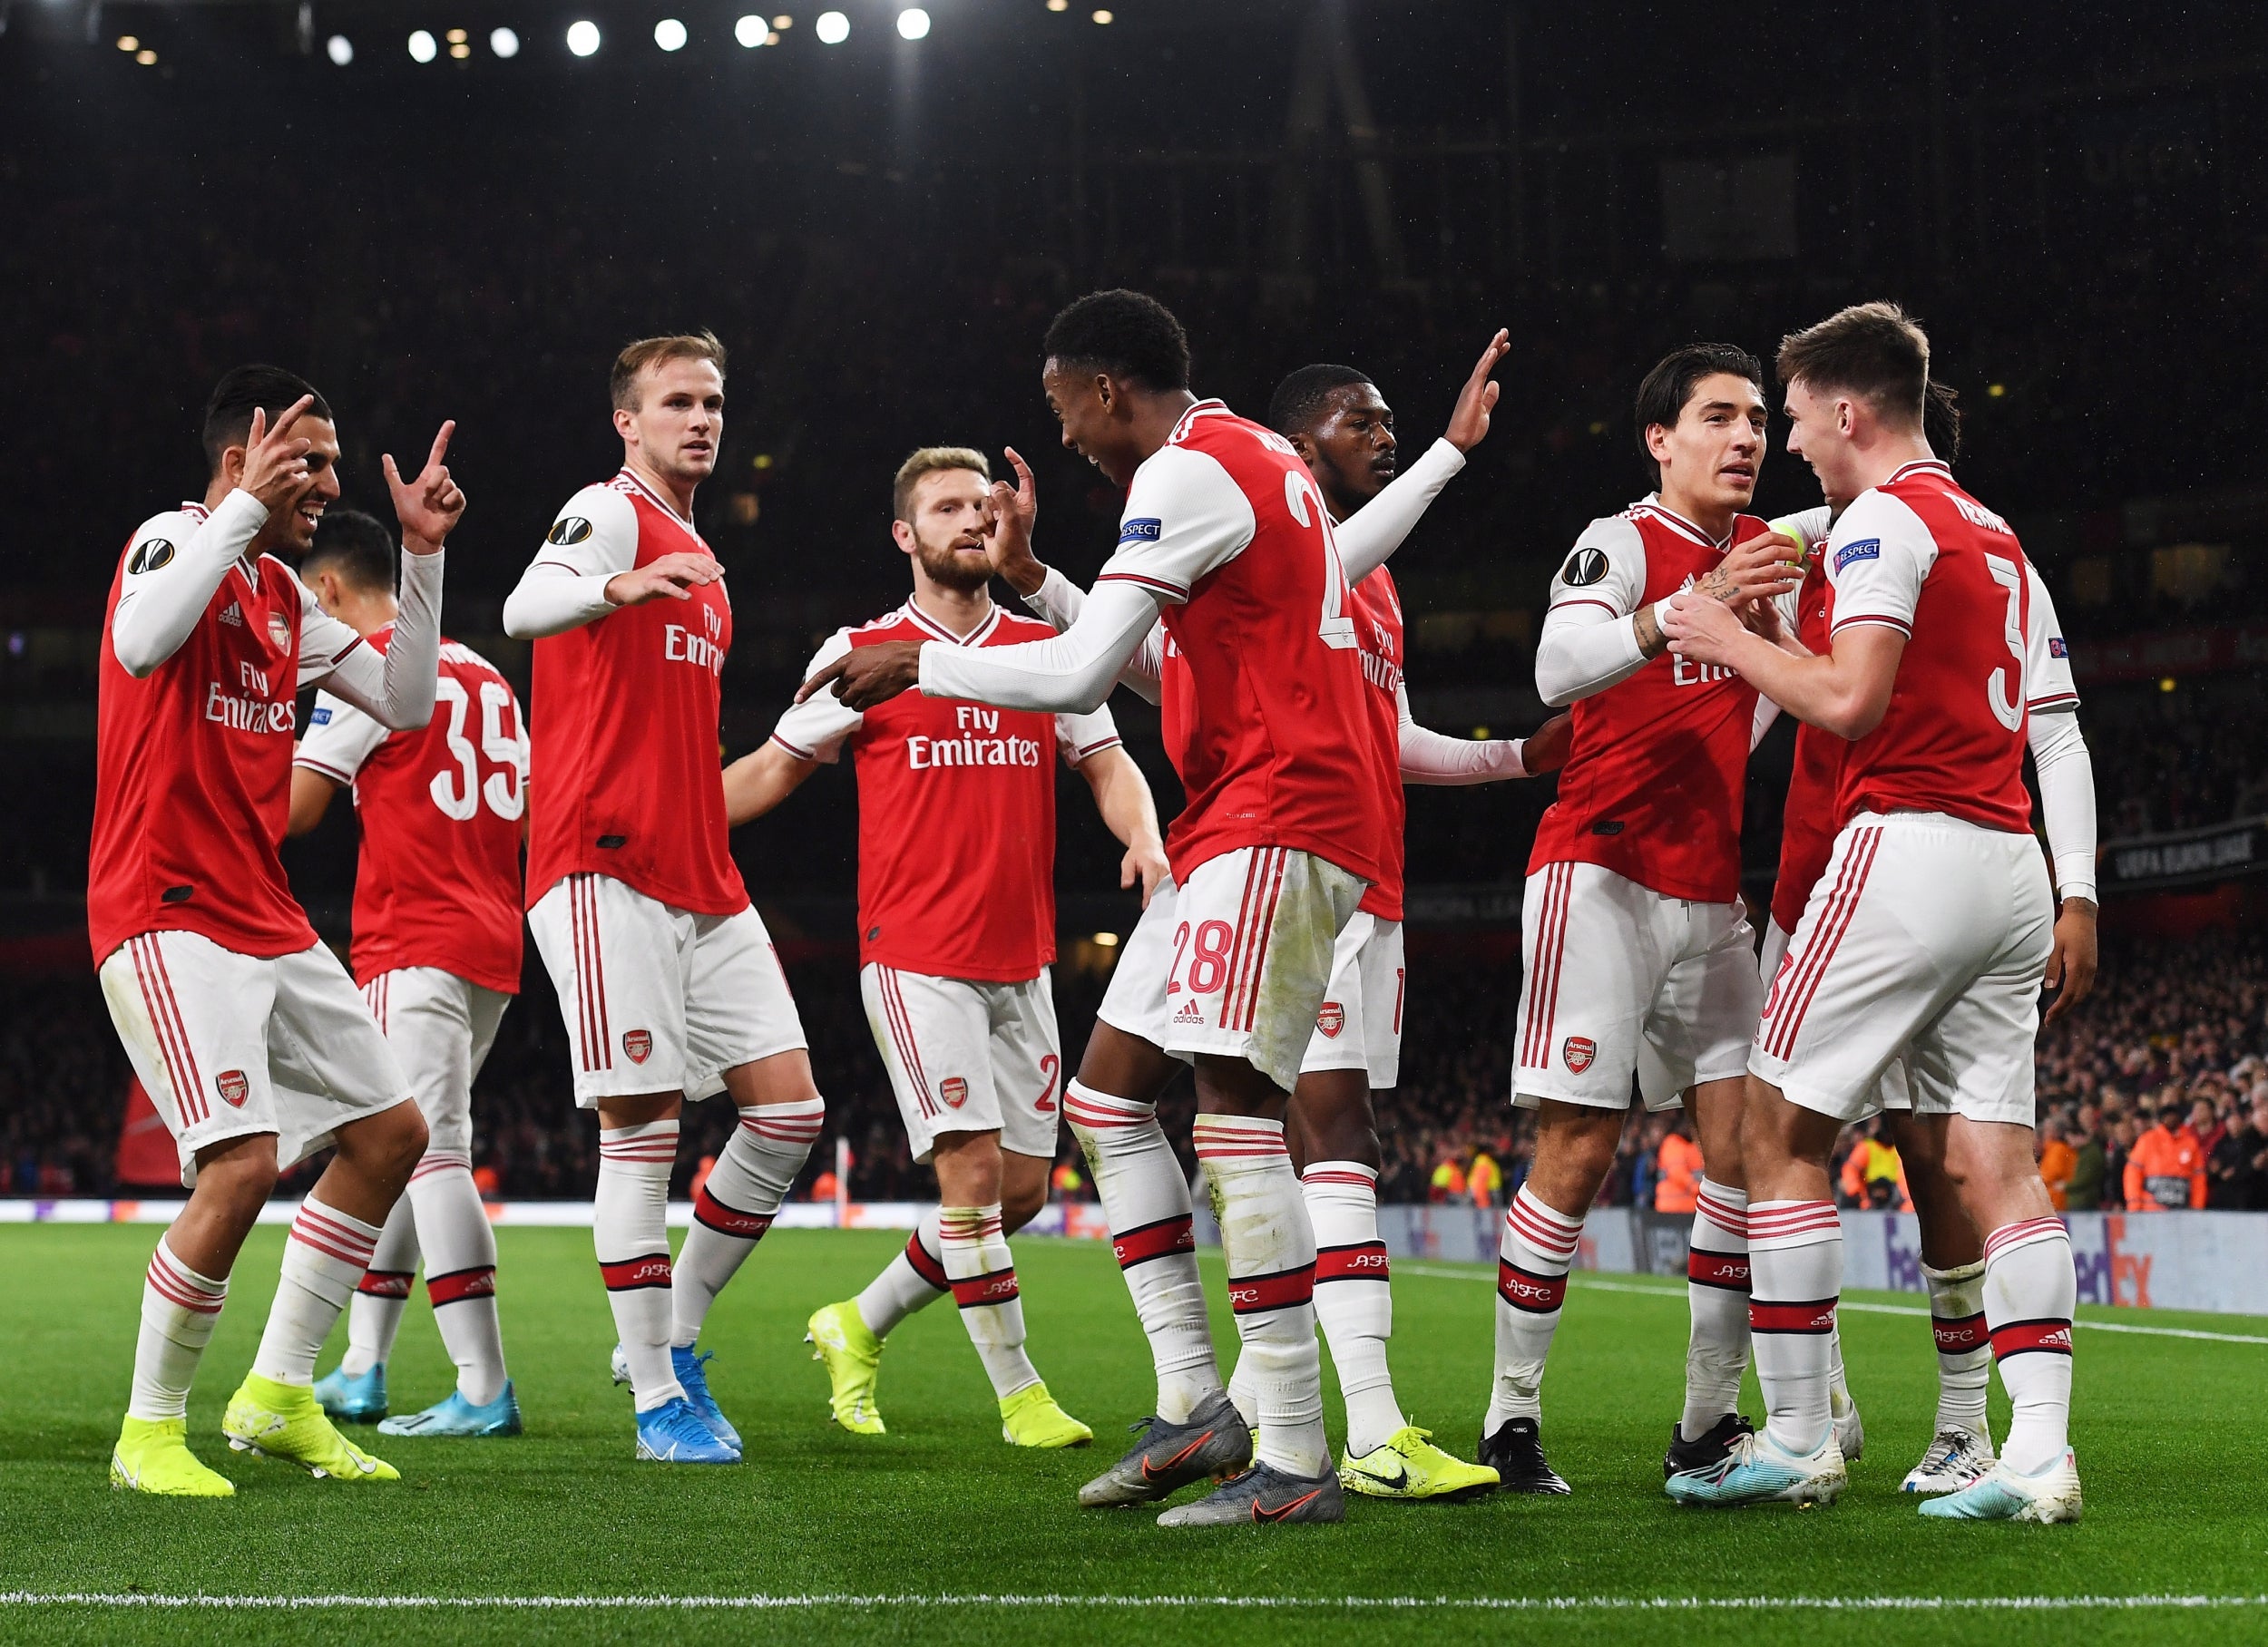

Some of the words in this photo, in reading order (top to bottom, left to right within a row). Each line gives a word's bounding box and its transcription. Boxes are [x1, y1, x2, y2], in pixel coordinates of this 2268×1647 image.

[1941, 491, 2013, 536] TIERNE
[1285, 470, 1358, 649] 2
[1840, 543, 1880, 563] RESPECT
[218, 614, 242, 628] adidas
[703, 603, 721, 640] Fly
[1371, 619, 1394, 657] Fly
[1983, 551, 2027, 733] 3
[240, 660, 269, 697] Fly
[1360, 648, 1400, 691] mira
[205, 681, 296, 734] Emiraes
[956, 706, 999, 734] Fly
[429, 676, 524, 822] 35
[906, 731, 1041, 769] Emirates
[1167, 919, 1234, 995] 28
[1173, 1013, 1205, 1025] adidas
[1568, 1041, 1593, 1051] Arsenal
[1713, 1264, 1749, 1279] AF
[1228, 1289, 1259, 1303] FC
